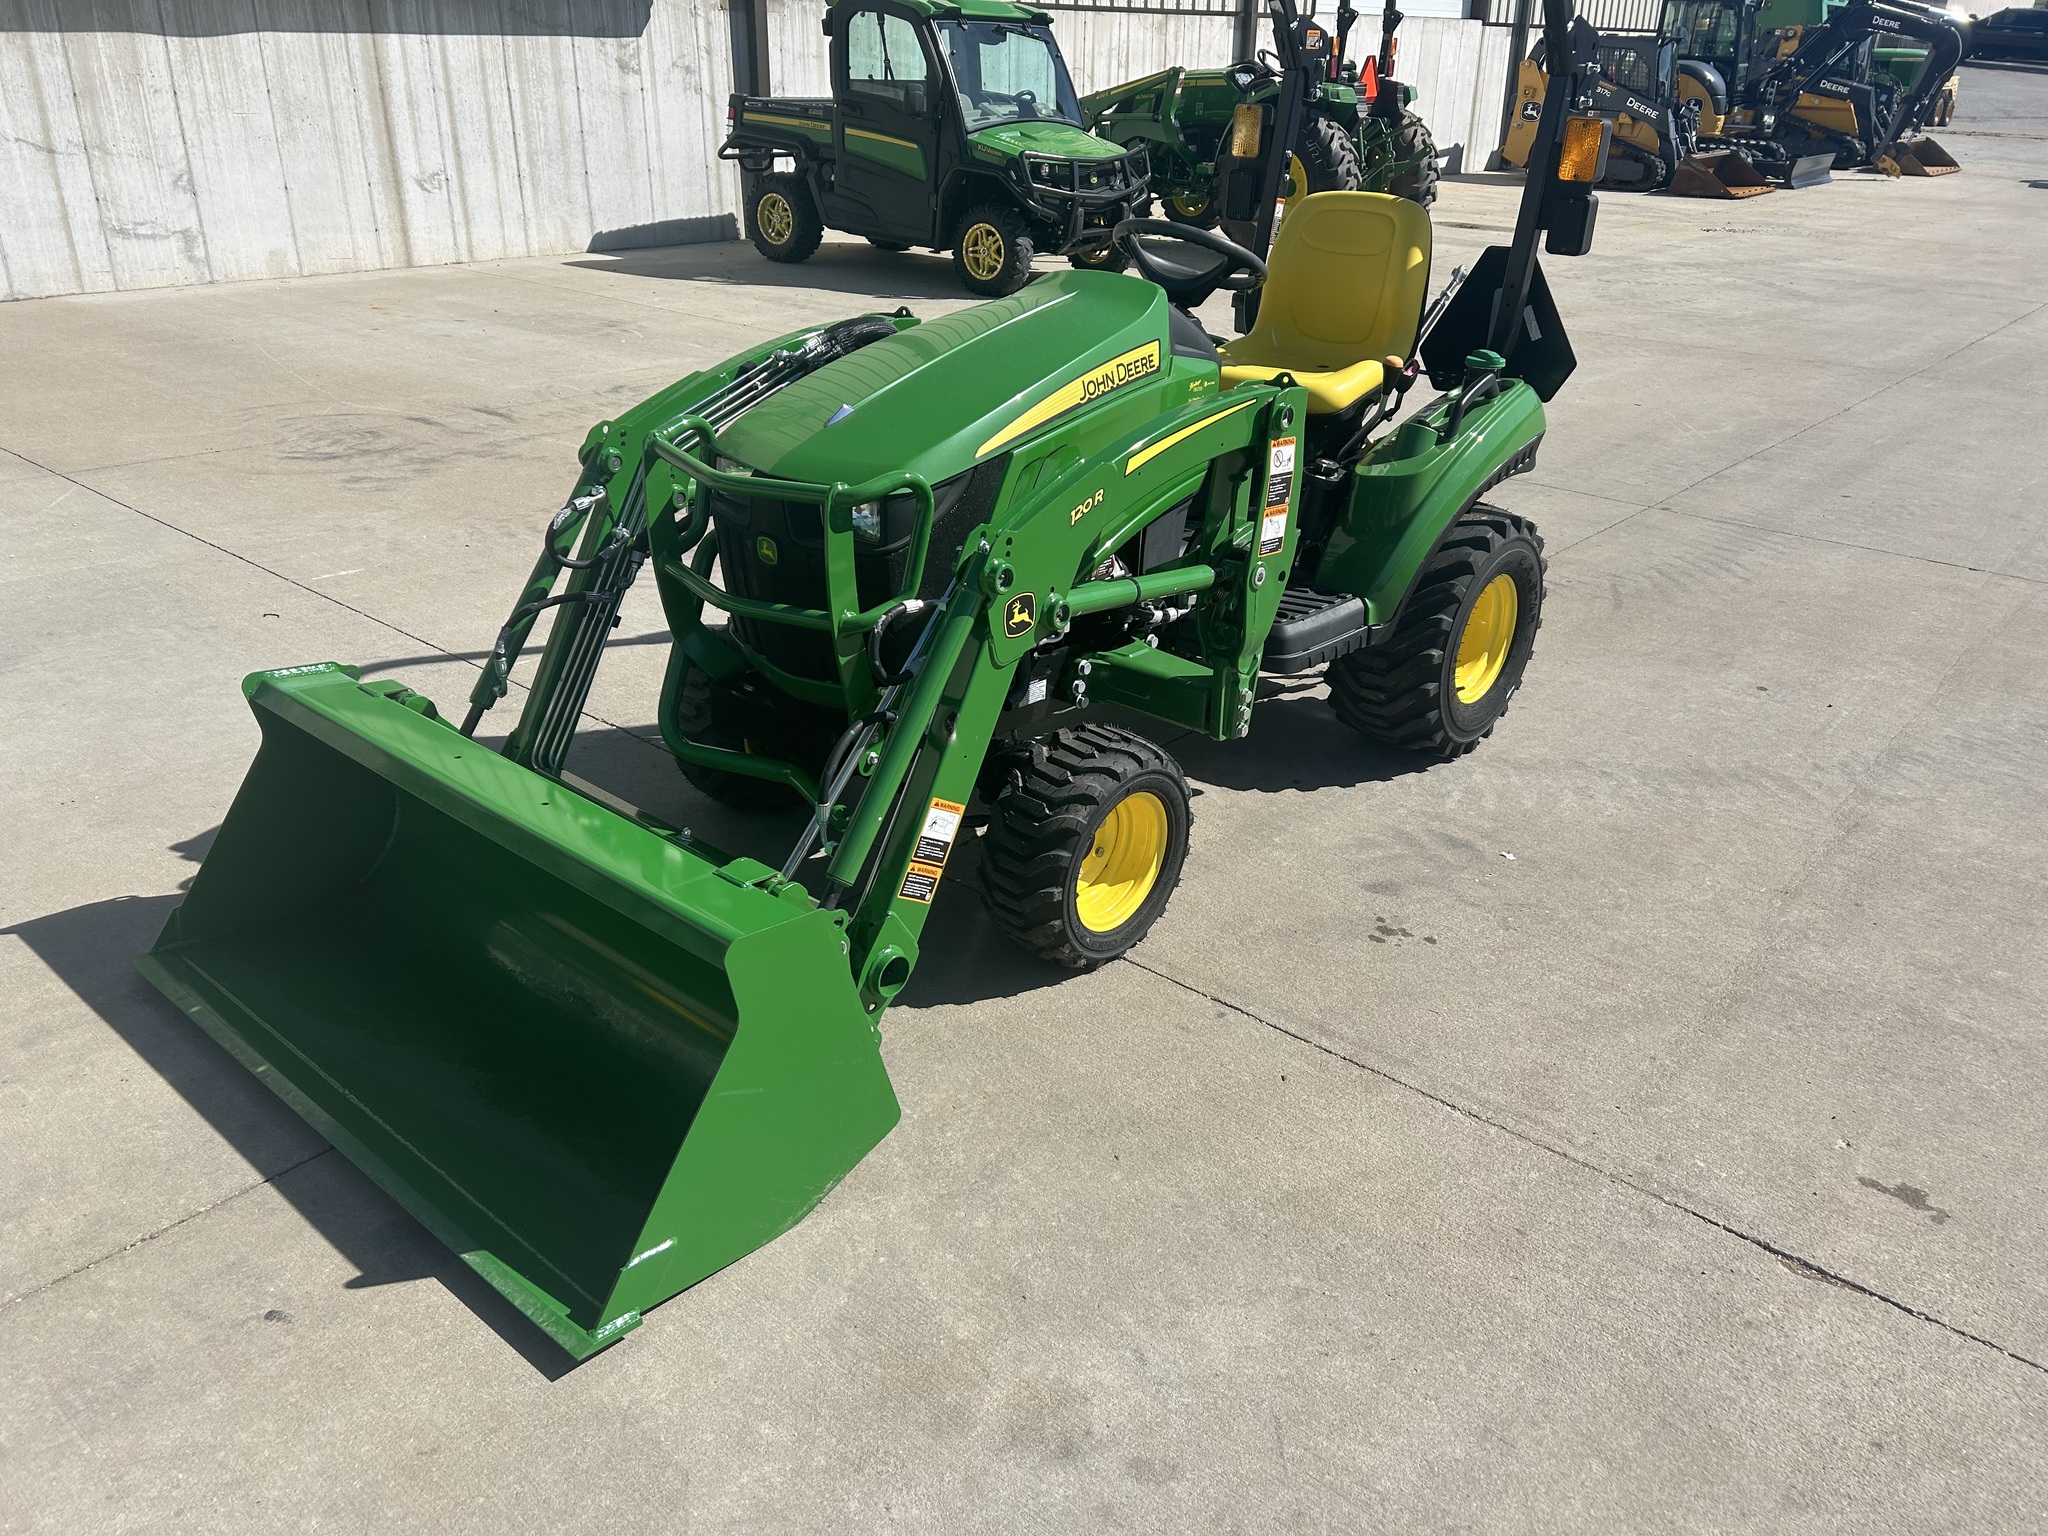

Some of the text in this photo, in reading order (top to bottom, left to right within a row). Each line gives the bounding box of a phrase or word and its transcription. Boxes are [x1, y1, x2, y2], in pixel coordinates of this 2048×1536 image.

[1872, 16, 1901, 29] DEERE
[1596, 86, 1612, 98] 317G
[1820, 80, 1850, 94] DEERE
[1626, 97, 1659, 119] DEERE
[1080, 353, 1155, 401] JOHN DEERE
[1276, 438, 1295, 447] WARNING
[1269, 507, 1287, 516] WARNING
[940, 803, 960, 812] WARNING
[916, 868, 938, 877] WARNING
